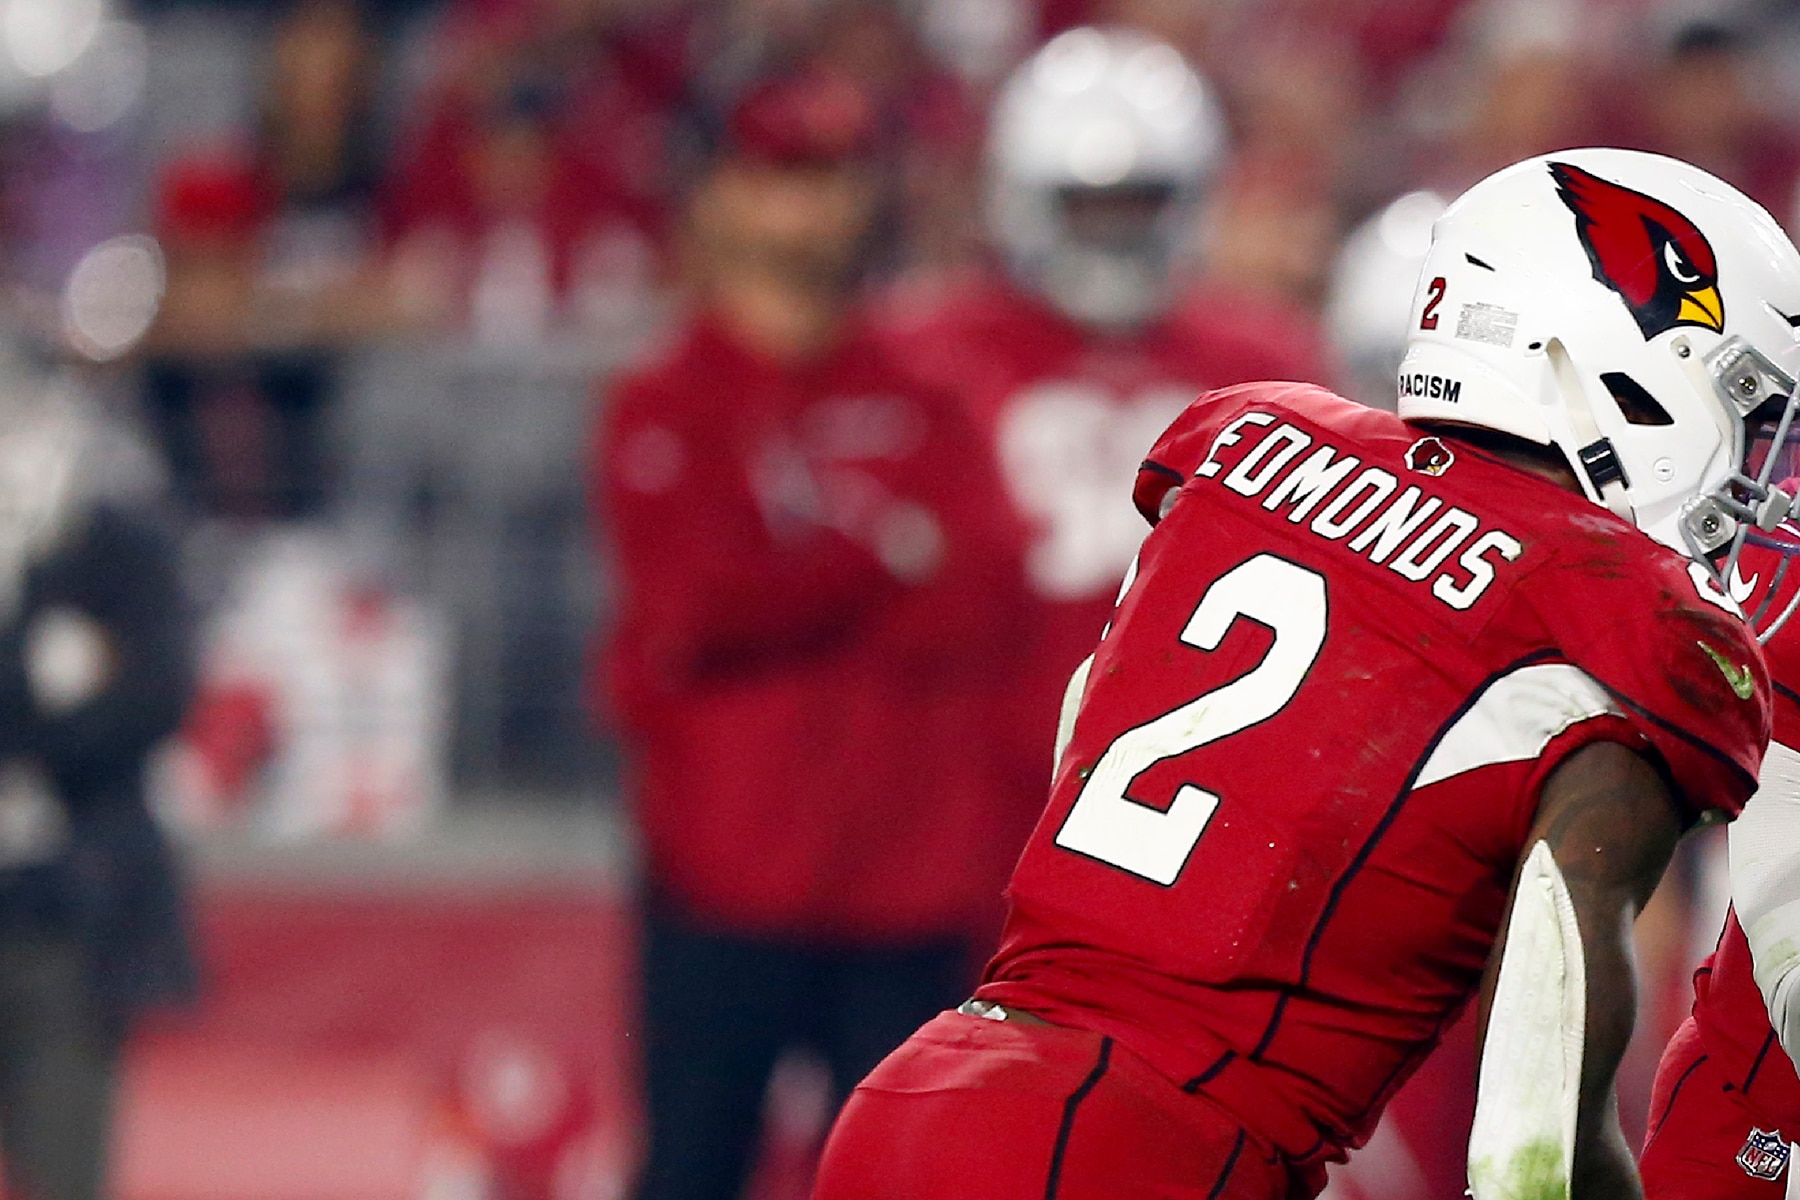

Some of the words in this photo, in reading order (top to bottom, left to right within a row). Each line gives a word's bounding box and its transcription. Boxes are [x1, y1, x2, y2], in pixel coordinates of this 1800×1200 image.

[1420, 276, 1446, 330] 2
[1195, 410, 1524, 612] EDMONDS
[1054, 551, 1328, 887] 2
